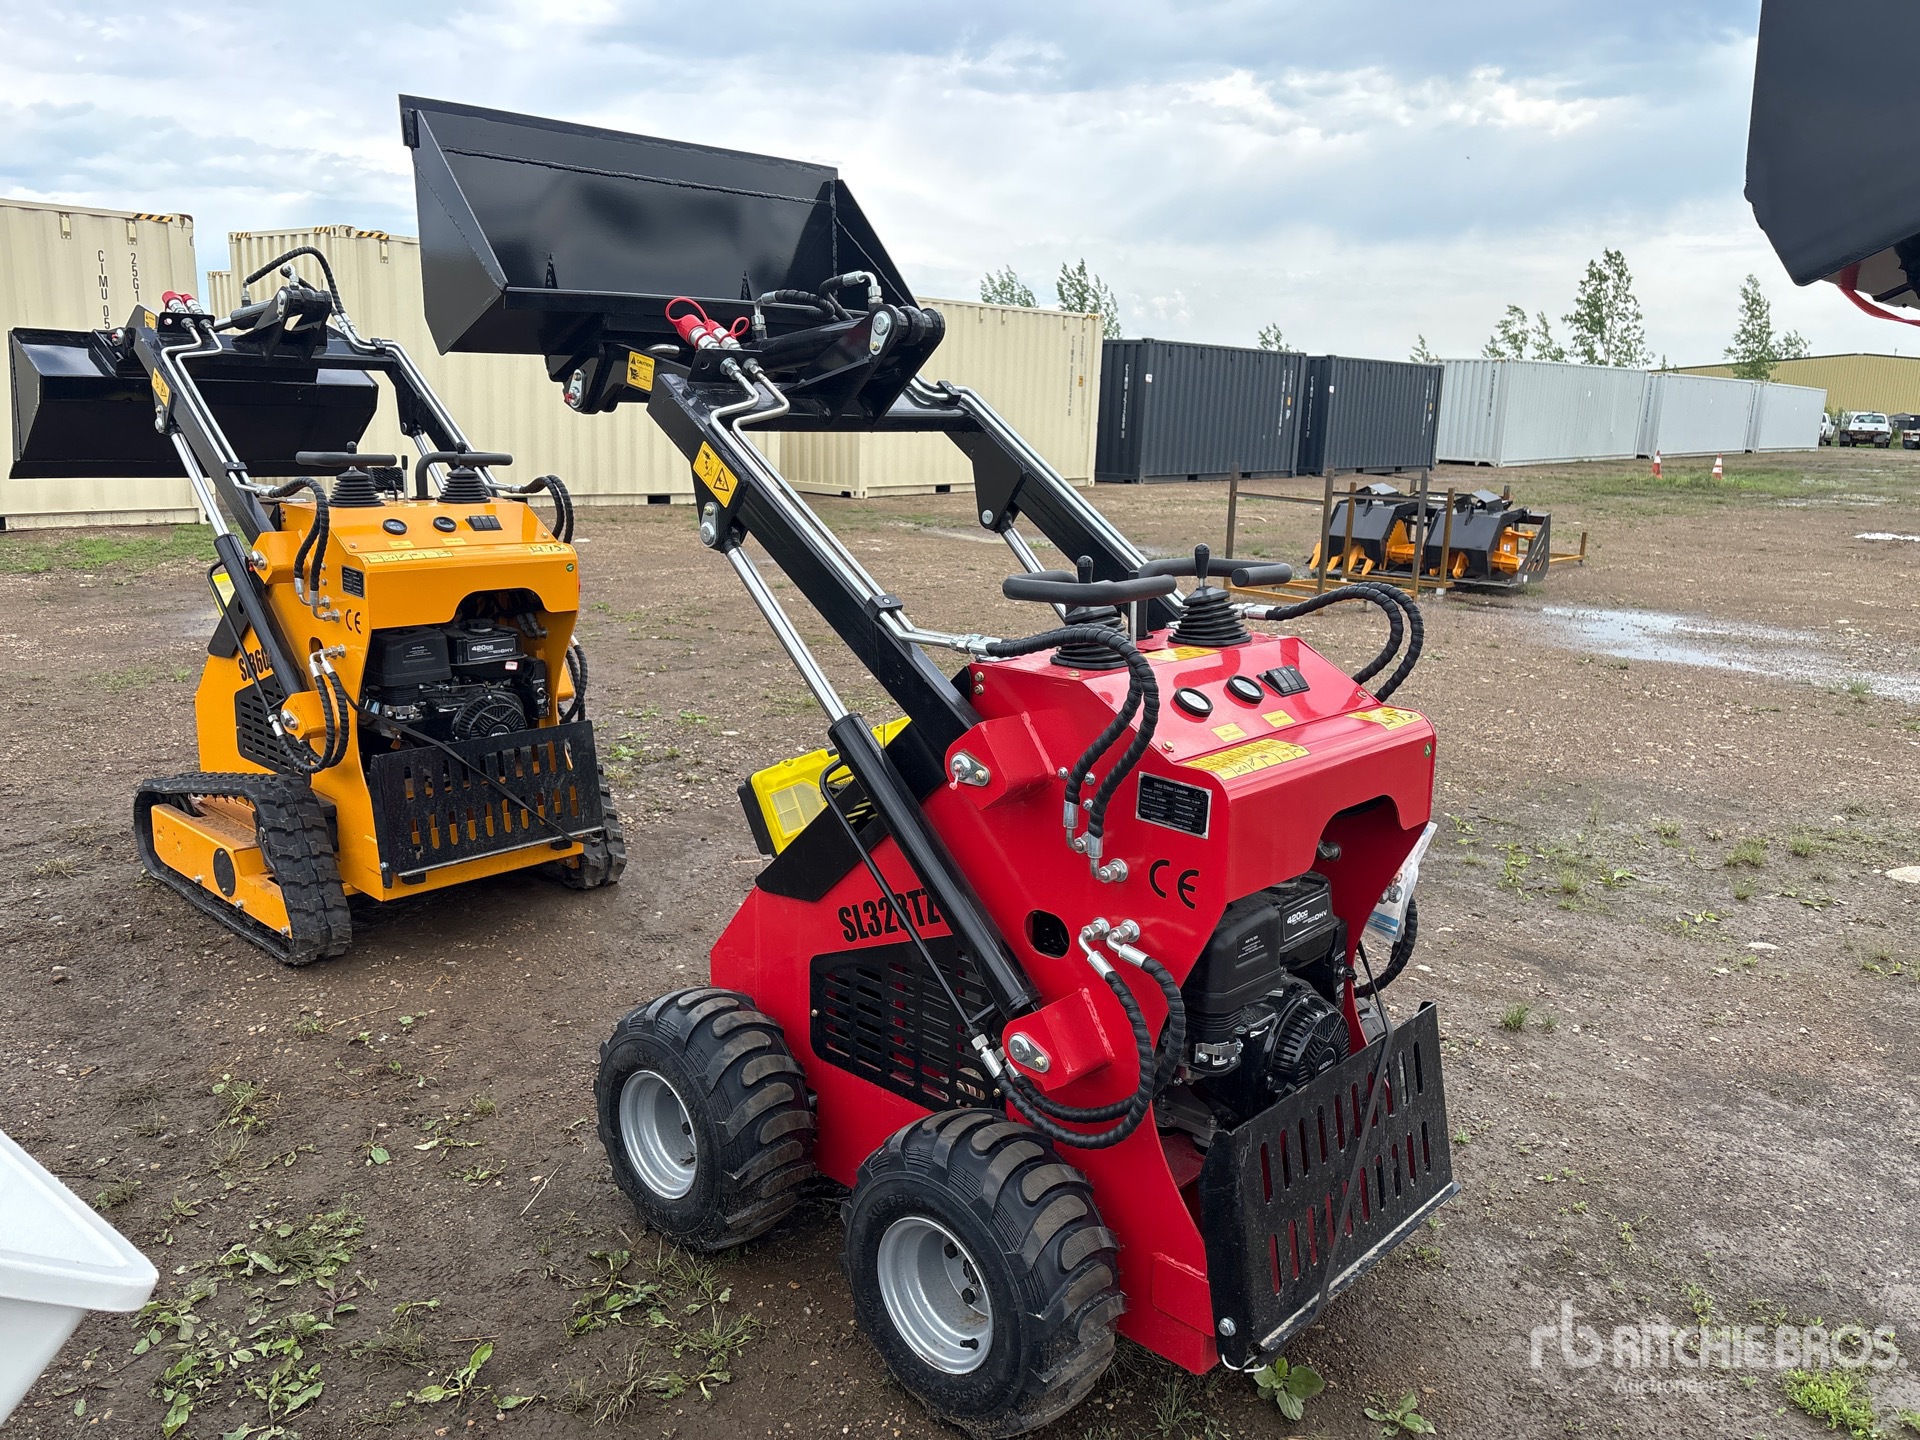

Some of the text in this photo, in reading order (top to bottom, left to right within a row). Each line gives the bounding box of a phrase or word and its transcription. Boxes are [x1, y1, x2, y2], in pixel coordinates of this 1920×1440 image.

[98, 250, 108, 300] CIMU
[130, 252, 140, 302] 25G1
[345, 608, 362, 635] CE
[1149, 858, 1200, 910] CE
[1286, 909, 1309, 925] 420cc
